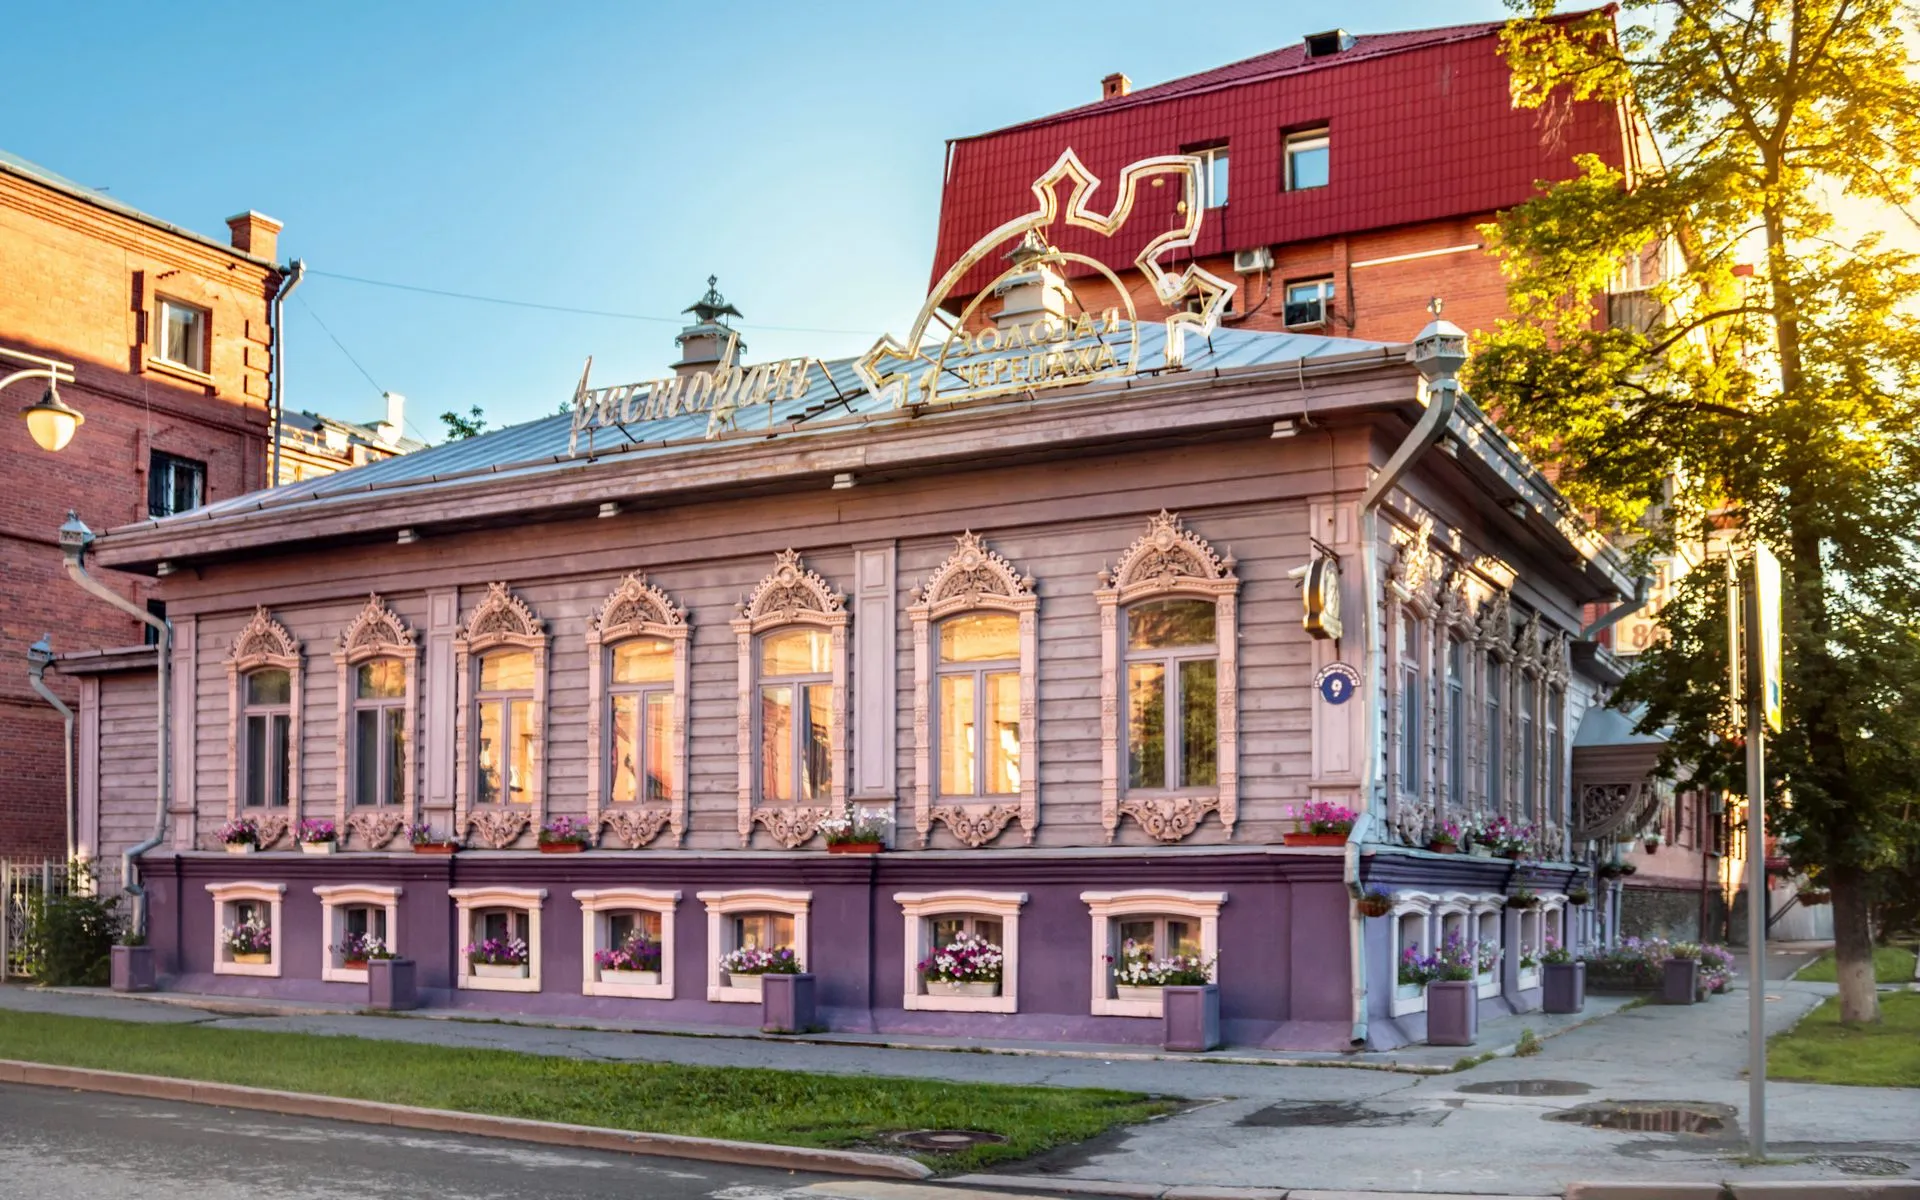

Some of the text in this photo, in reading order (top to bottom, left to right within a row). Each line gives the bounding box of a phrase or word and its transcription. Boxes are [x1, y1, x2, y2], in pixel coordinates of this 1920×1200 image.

[958, 342, 1118, 389] ЧЕРЕПАХА
[568, 331, 811, 457] ресторан
[1331, 679, 1342, 698] 9
